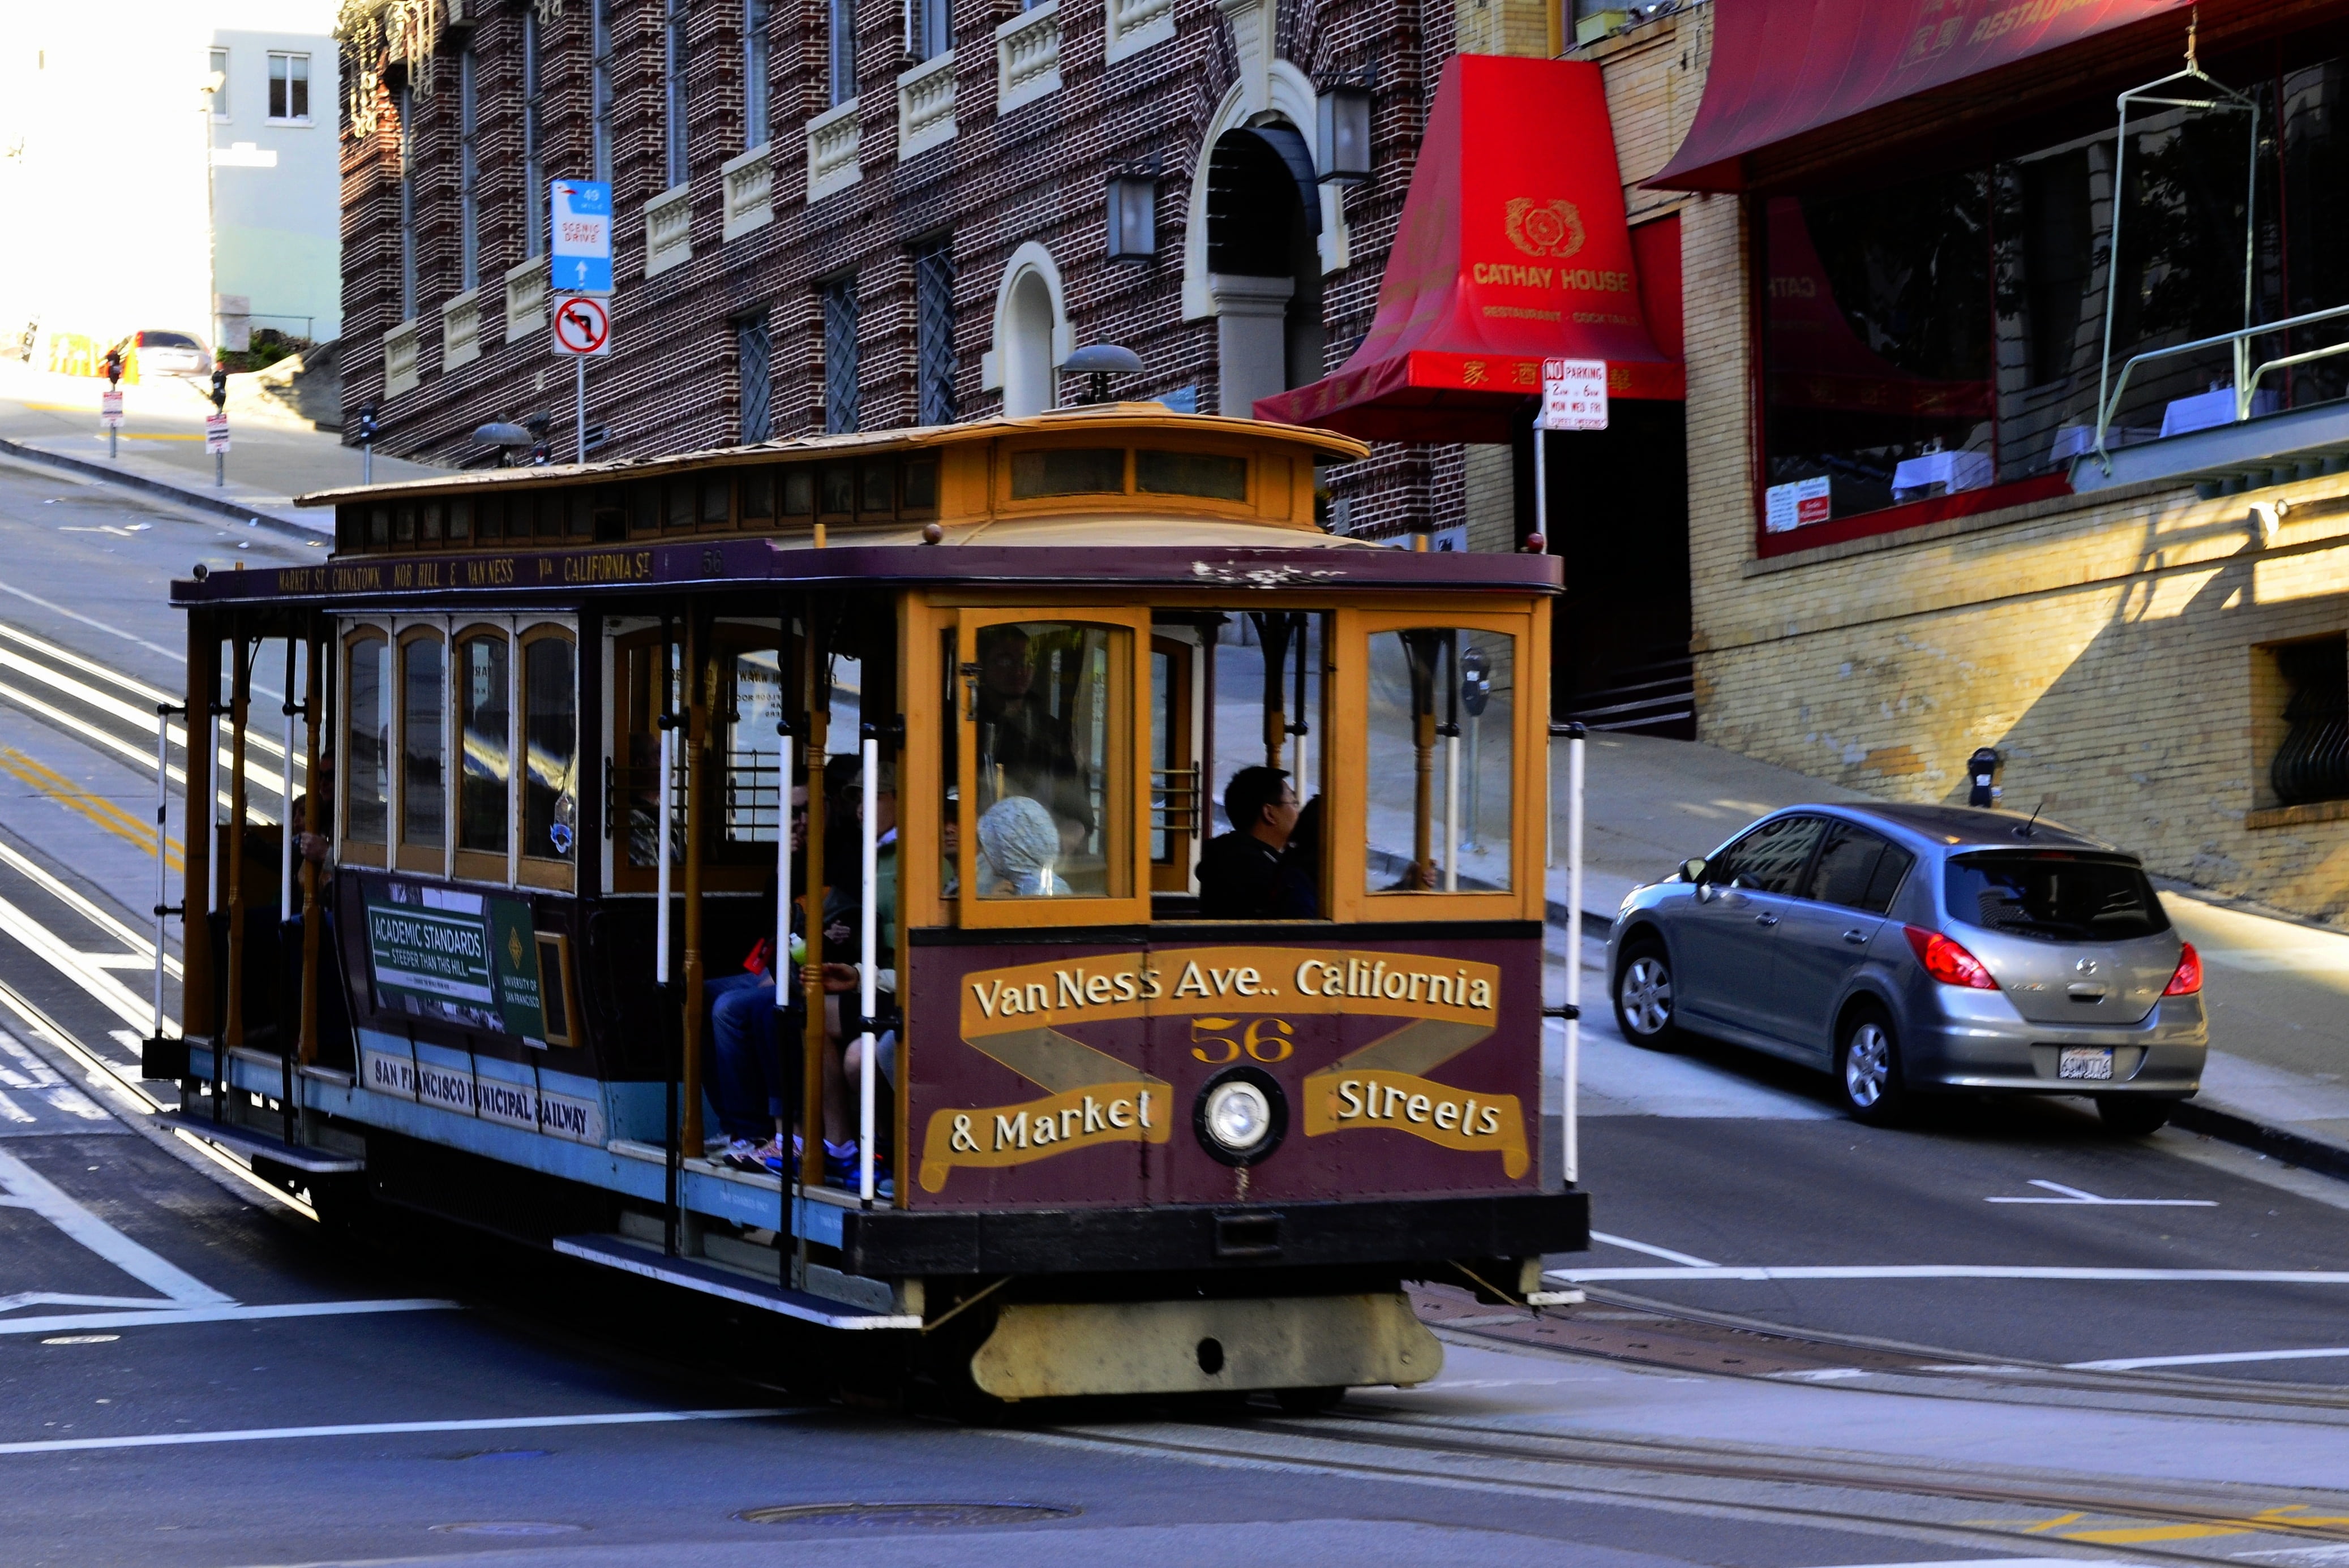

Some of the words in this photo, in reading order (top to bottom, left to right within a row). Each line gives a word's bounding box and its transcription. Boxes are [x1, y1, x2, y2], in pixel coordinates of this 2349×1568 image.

[583, 189, 599, 201] 49
[562, 221, 600, 234] SCENIC
[565, 233, 597, 243] DRIVE
[1473, 262, 1553, 289] CATHAY
[1561, 268, 1630, 293] HOUSE
[1482, 306, 1561, 322] RESTAURANT
[1546, 362, 1563, 379] NO
[1566, 367, 1602, 380] PARKING
[1551, 401, 1566, 412] MON
[1571, 401, 1585, 413] WED
[1589, 402, 1601, 414] FRI
[278, 570, 310, 592] MARKET
[395, 564, 412, 587] NOB
[418, 562, 439, 587] HILL
[468, 560, 485, 585] VAN
[488, 559, 514, 584] NESS
[564, 554, 632, 582] CALIFORNIA
[375, 917, 422, 948] ACADEMIC
[424, 925, 481, 959] STANDARDS
[391, 948, 419, 968] STEEPER
[419, 953, 438, 971] THAN
[438, 956, 452, 974] THIS
[452, 961, 469, 978] HILL.
[503, 974, 529, 990] UNIVERSITY
[530, 979, 537, 991] OF
[971, 978, 1049, 1019] Van
[1054, 968, 1162, 1010] Ness
[1294, 957, 1493, 1011] California
[505, 991, 514, 1004] SAN
[514, 992, 539, 1008] FRANCISCO
[1190, 1017, 1295, 1064] 56
[375, 1058, 397, 1087] SAN
[2084, 1071, 2113, 1080] CHALET
[1337, 1079, 1502, 1136] Streets
[950, 1113, 979, 1152] &
[994, 1089, 1152, 1152] Market
